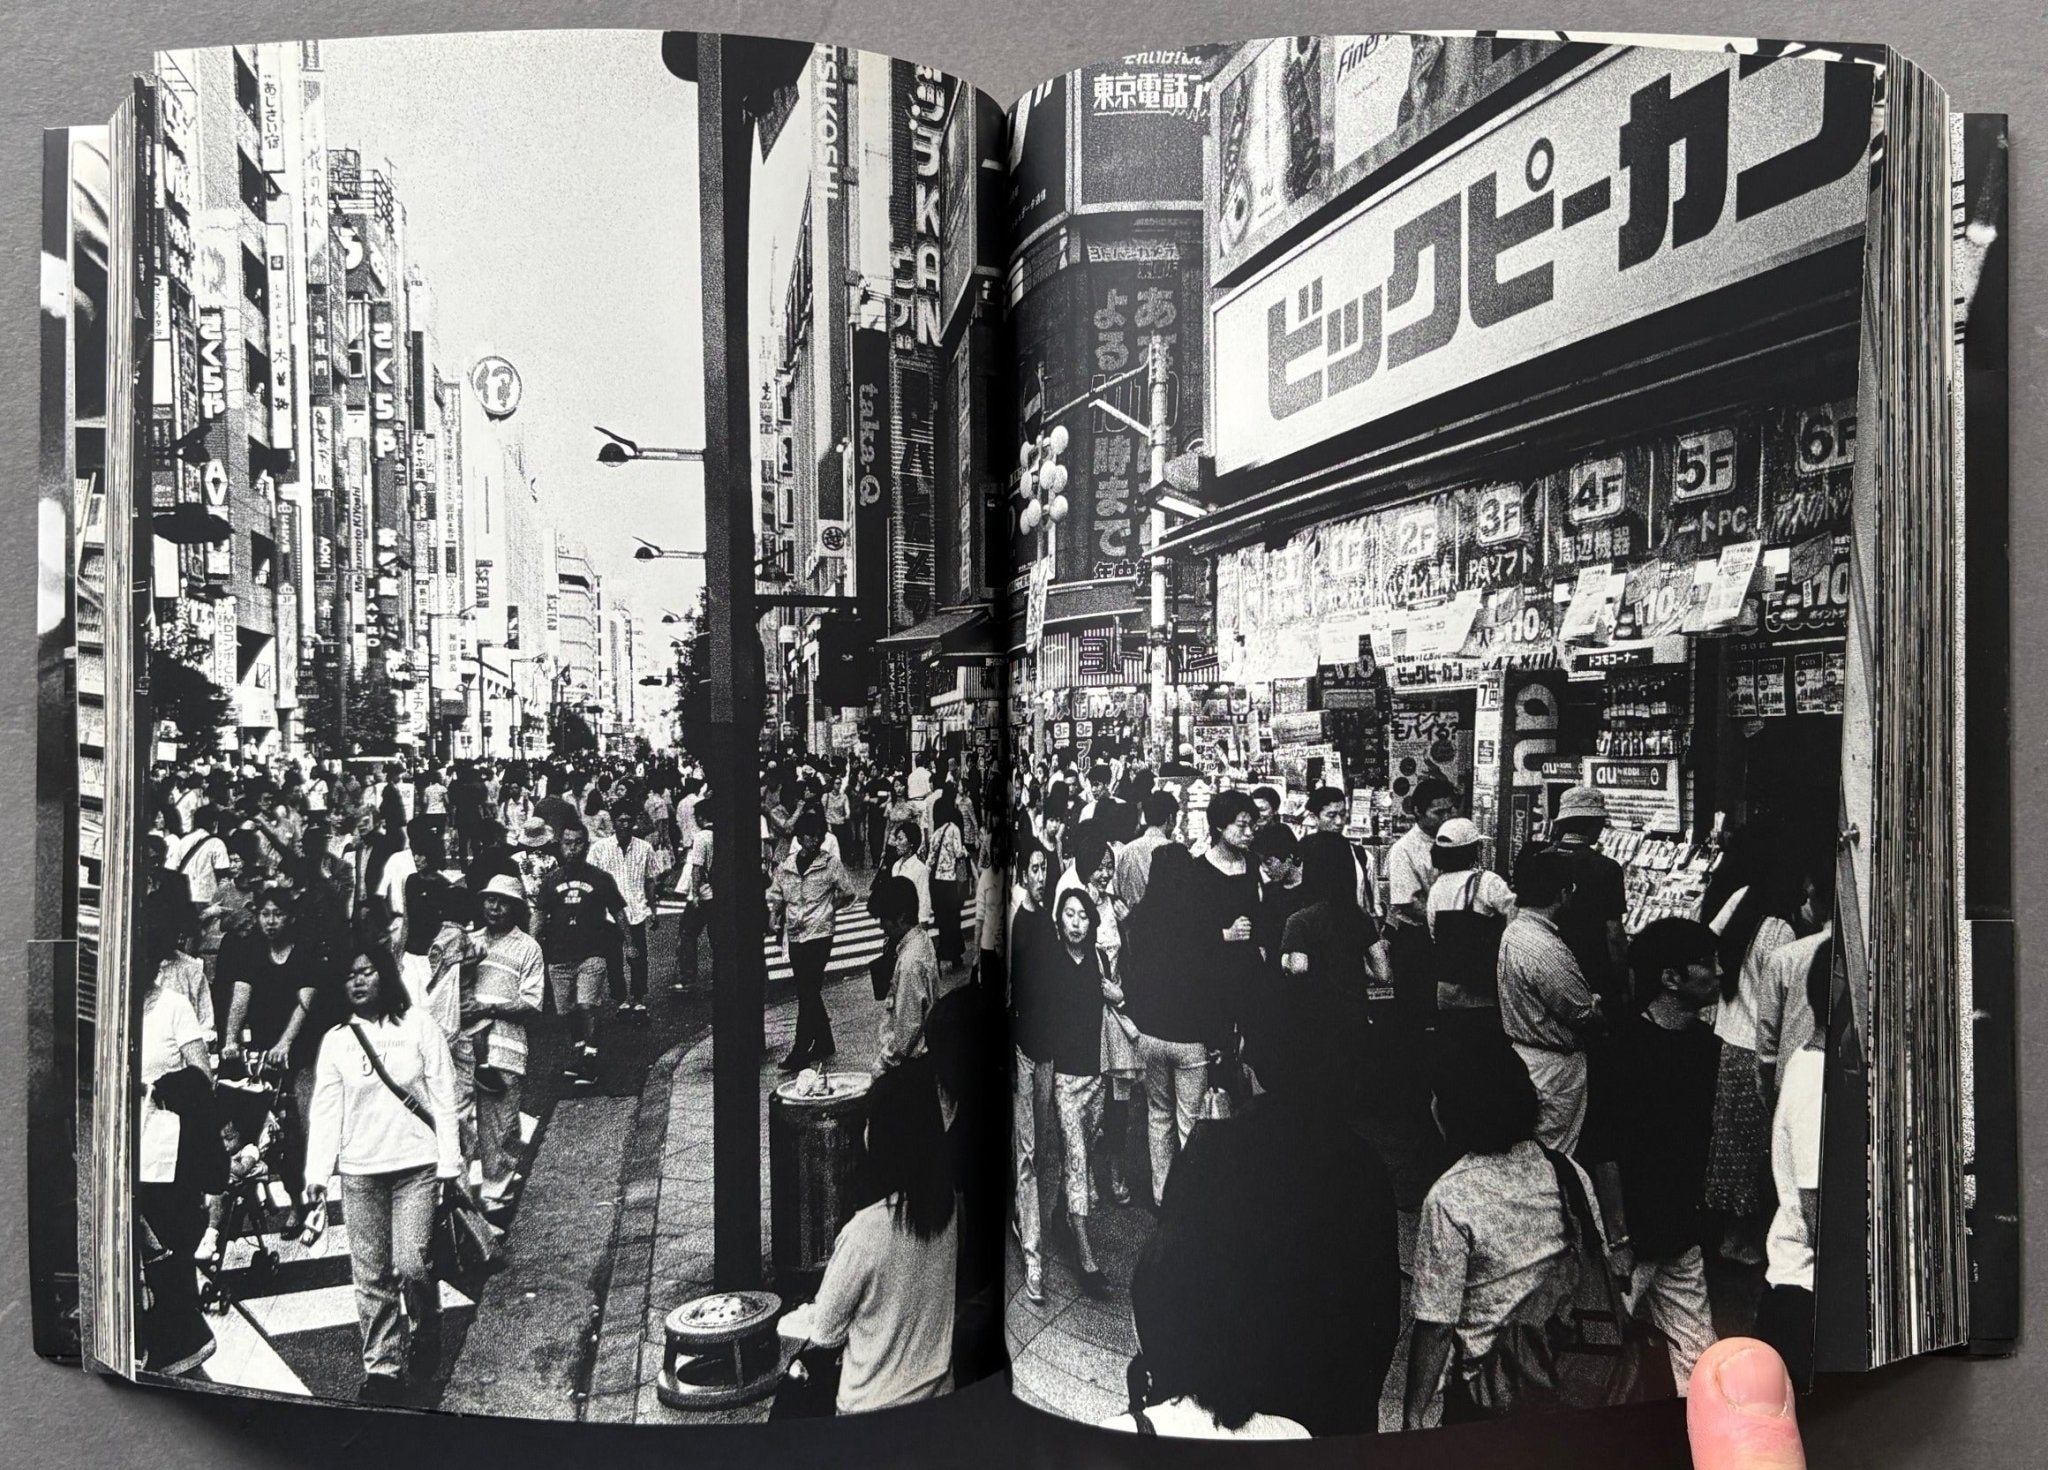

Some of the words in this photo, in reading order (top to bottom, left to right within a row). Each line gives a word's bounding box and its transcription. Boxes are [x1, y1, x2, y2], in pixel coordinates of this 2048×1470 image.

[1267, 57, 1874, 421] ビックピーカン
[199, 310, 226, 419] さくらや
[373, 322, 397, 458] さくらや
[1676, 444, 1734, 492] 5F
[1574, 472, 1625, 511] 4F
[1481, 498, 1521, 537] 3F
[318, 535, 331, 568] AOKI
[1077, 723, 1092, 736] 3F
[1512, 684, 1558, 787] au
[1541, 762, 1557, 775] au
[1596, 766, 1617, 785] au
